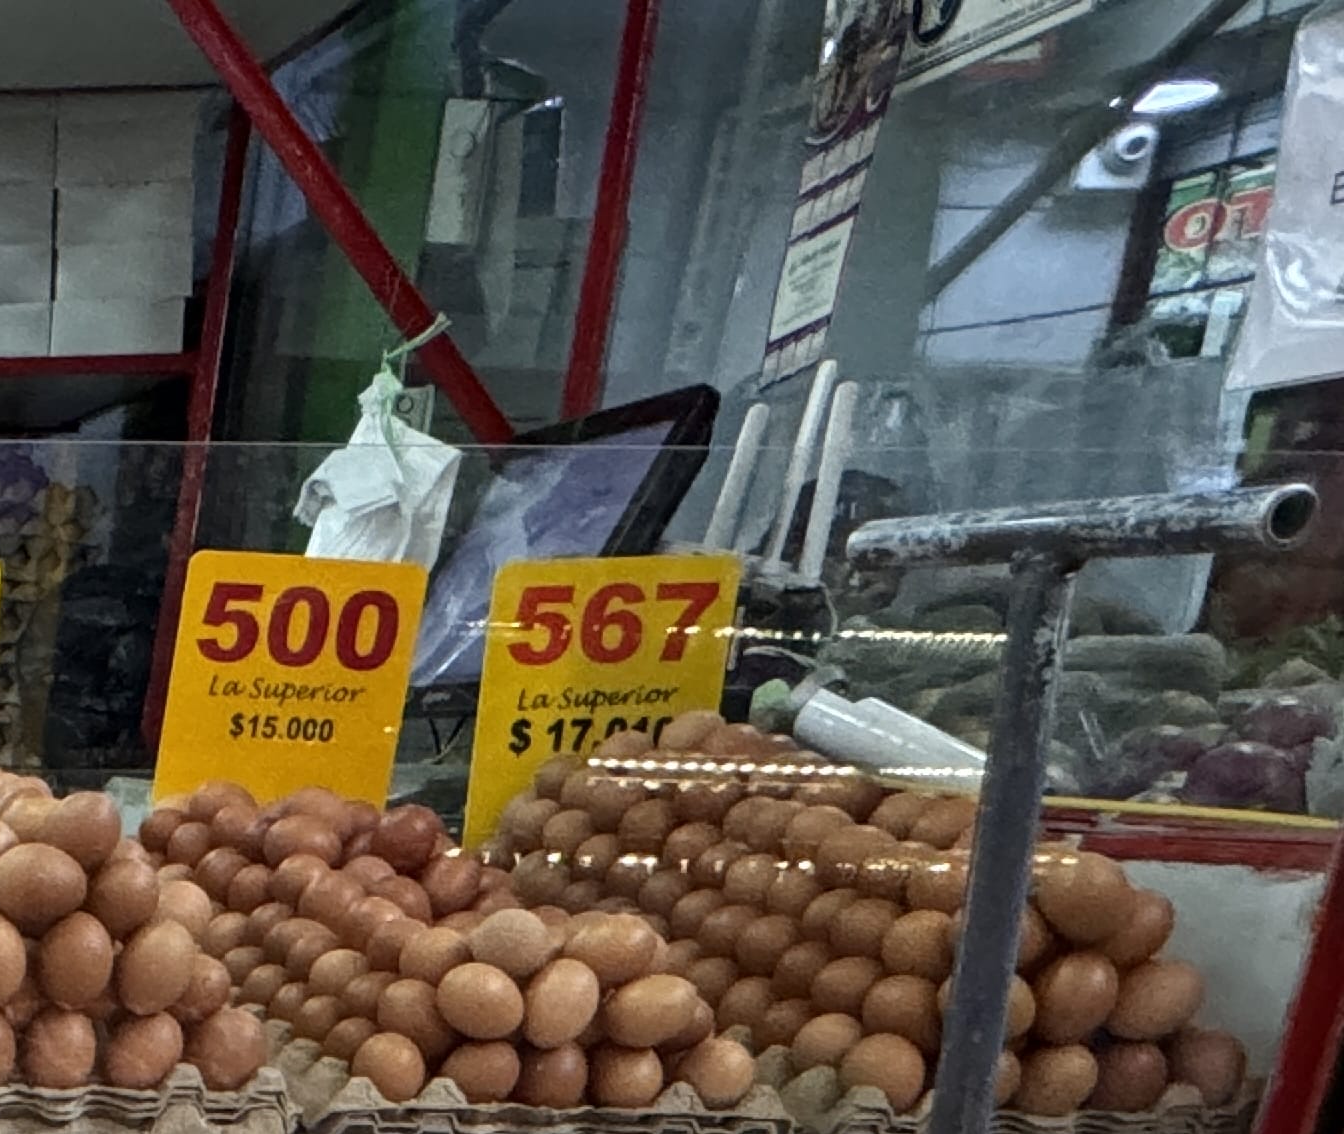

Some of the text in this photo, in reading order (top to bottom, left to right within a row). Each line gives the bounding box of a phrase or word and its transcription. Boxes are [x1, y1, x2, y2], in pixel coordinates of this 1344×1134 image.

[196, 582, 399, 671] 500
[508, 582, 721, 666] 567
[208, 676, 367, 705] La Superior
[518, 684, 678, 712] La Superior
[229, 713, 334, 743] $15.000
[508, 719, 532, 755] $
